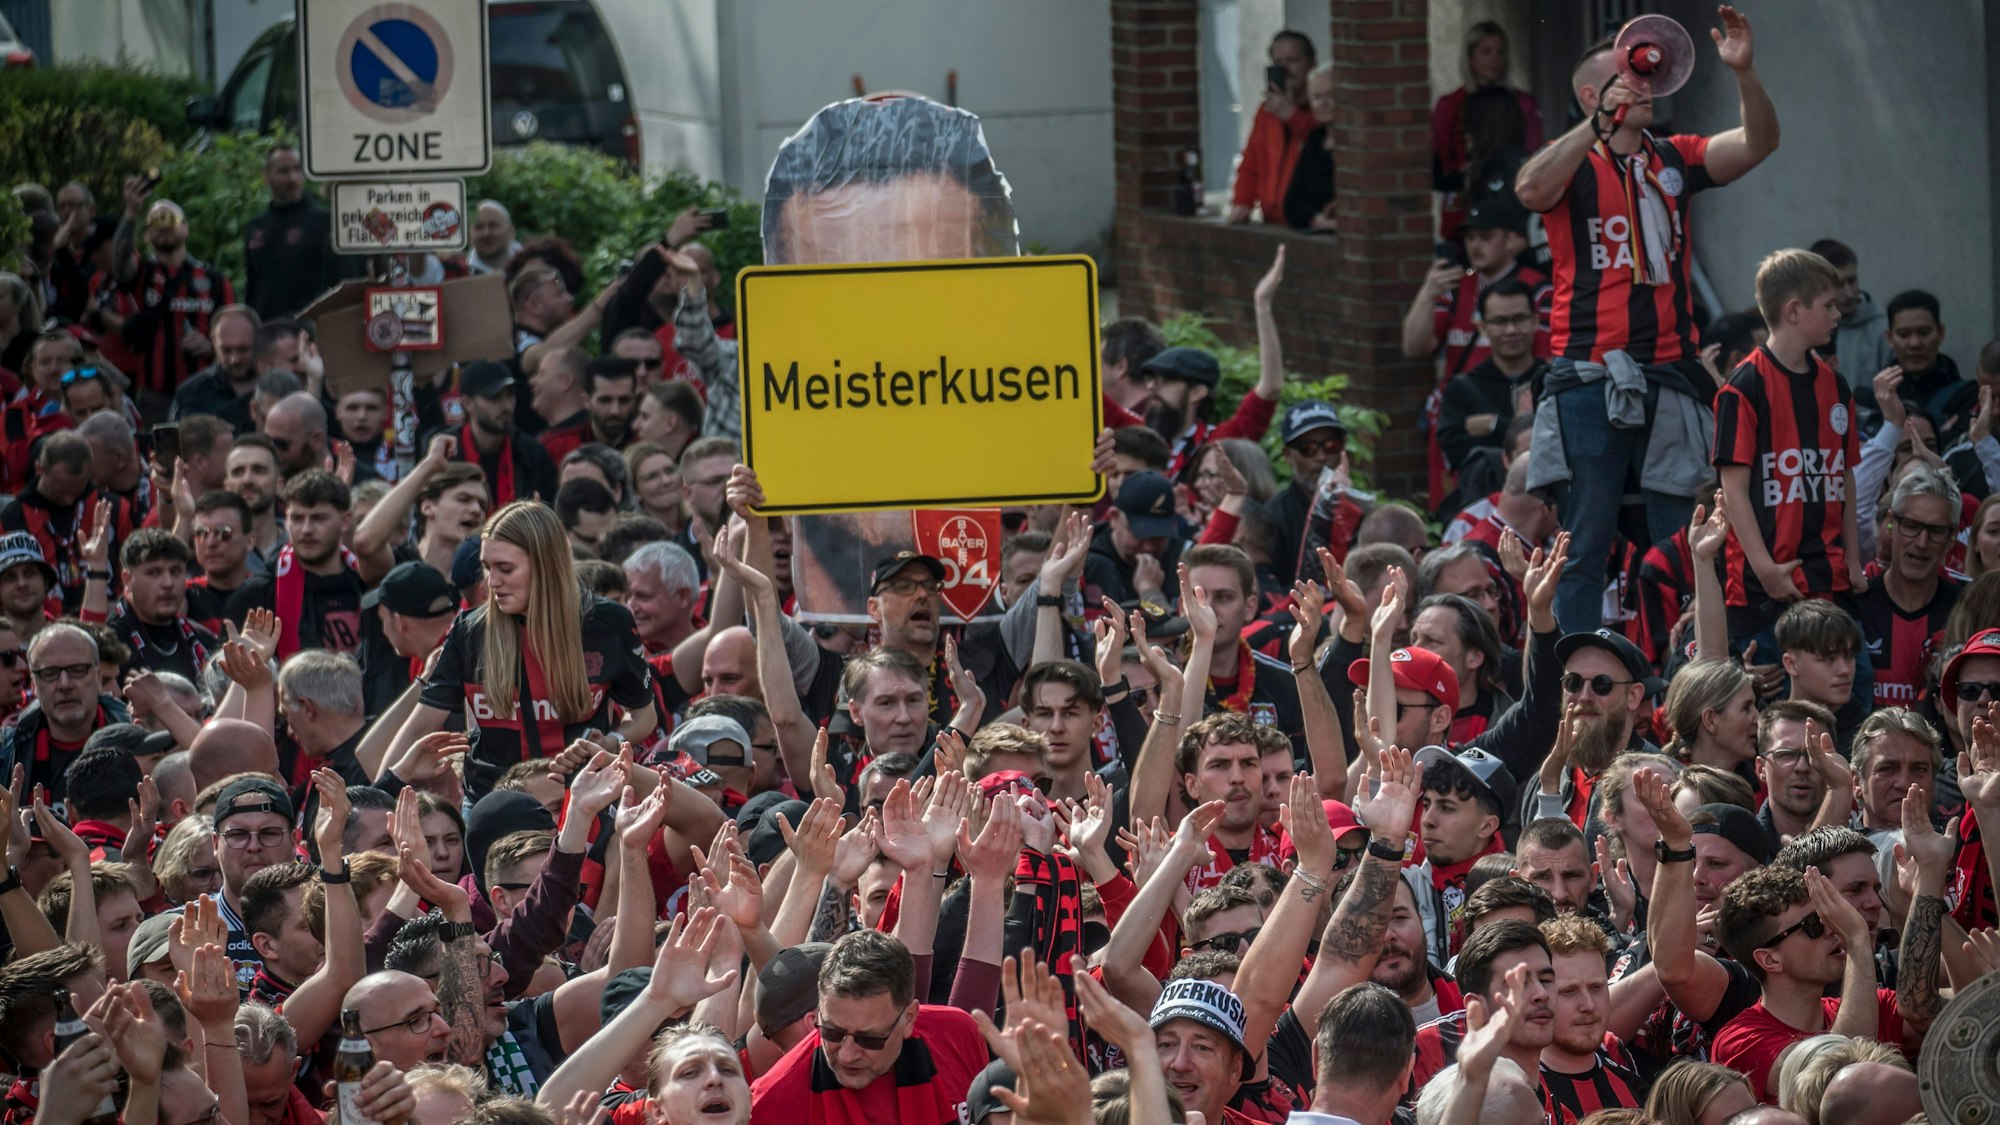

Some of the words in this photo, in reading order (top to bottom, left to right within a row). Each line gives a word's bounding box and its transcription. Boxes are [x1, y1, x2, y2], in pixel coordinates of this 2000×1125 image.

[353, 131, 443, 163] ZONE
[367, 188, 413, 205] Parken
[418, 188, 431, 203] in
[762, 354, 1081, 412] Meisterkusen
[1762, 447, 1845, 480] FORZA
[941, 537, 985, 549] BAYER
[939, 557, 992, 590] 04
